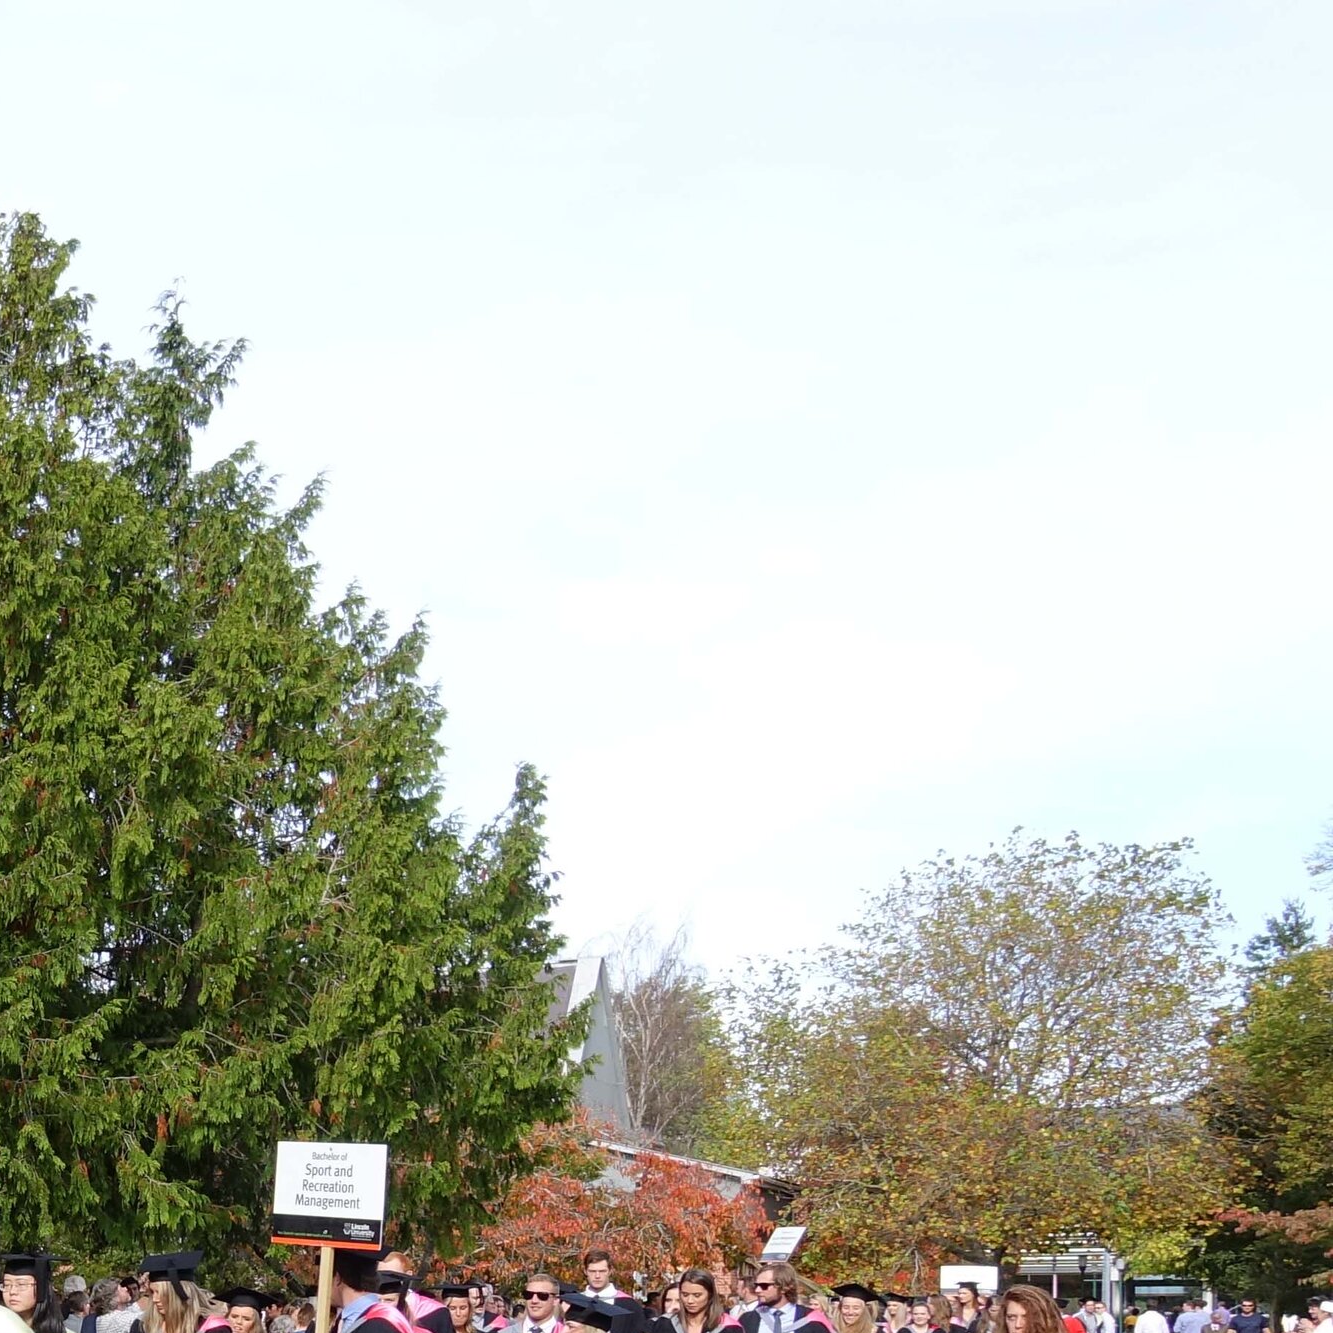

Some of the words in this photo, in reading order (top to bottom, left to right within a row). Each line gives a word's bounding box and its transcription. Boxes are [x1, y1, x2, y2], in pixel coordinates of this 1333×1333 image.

[312, 1151, 340, 1161] Bachelor
[340, 1152, 348, 1161] of
[305, 1163, 332, 1179] Sport
[334, 1164, 353, 1177] and
[302, 1178, 354, 1193] Recreation
[295, 1193, 360, 1210] Management
